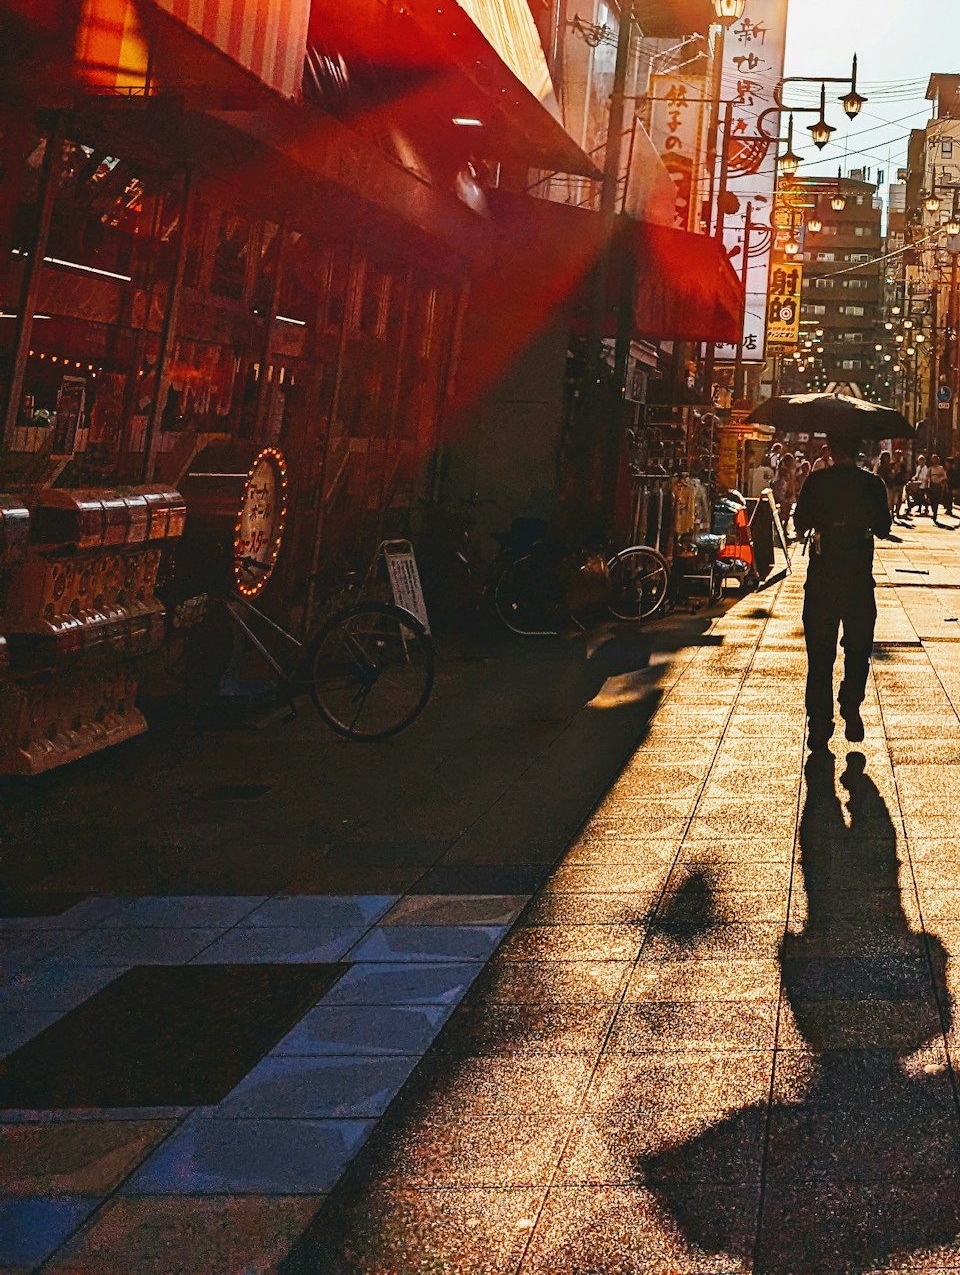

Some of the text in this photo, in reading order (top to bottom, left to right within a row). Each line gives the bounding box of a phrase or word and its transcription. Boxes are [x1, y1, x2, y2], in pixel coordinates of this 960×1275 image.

[733, 17, 774, 107] 新世界
[769, 268, 799, 326] 射的
